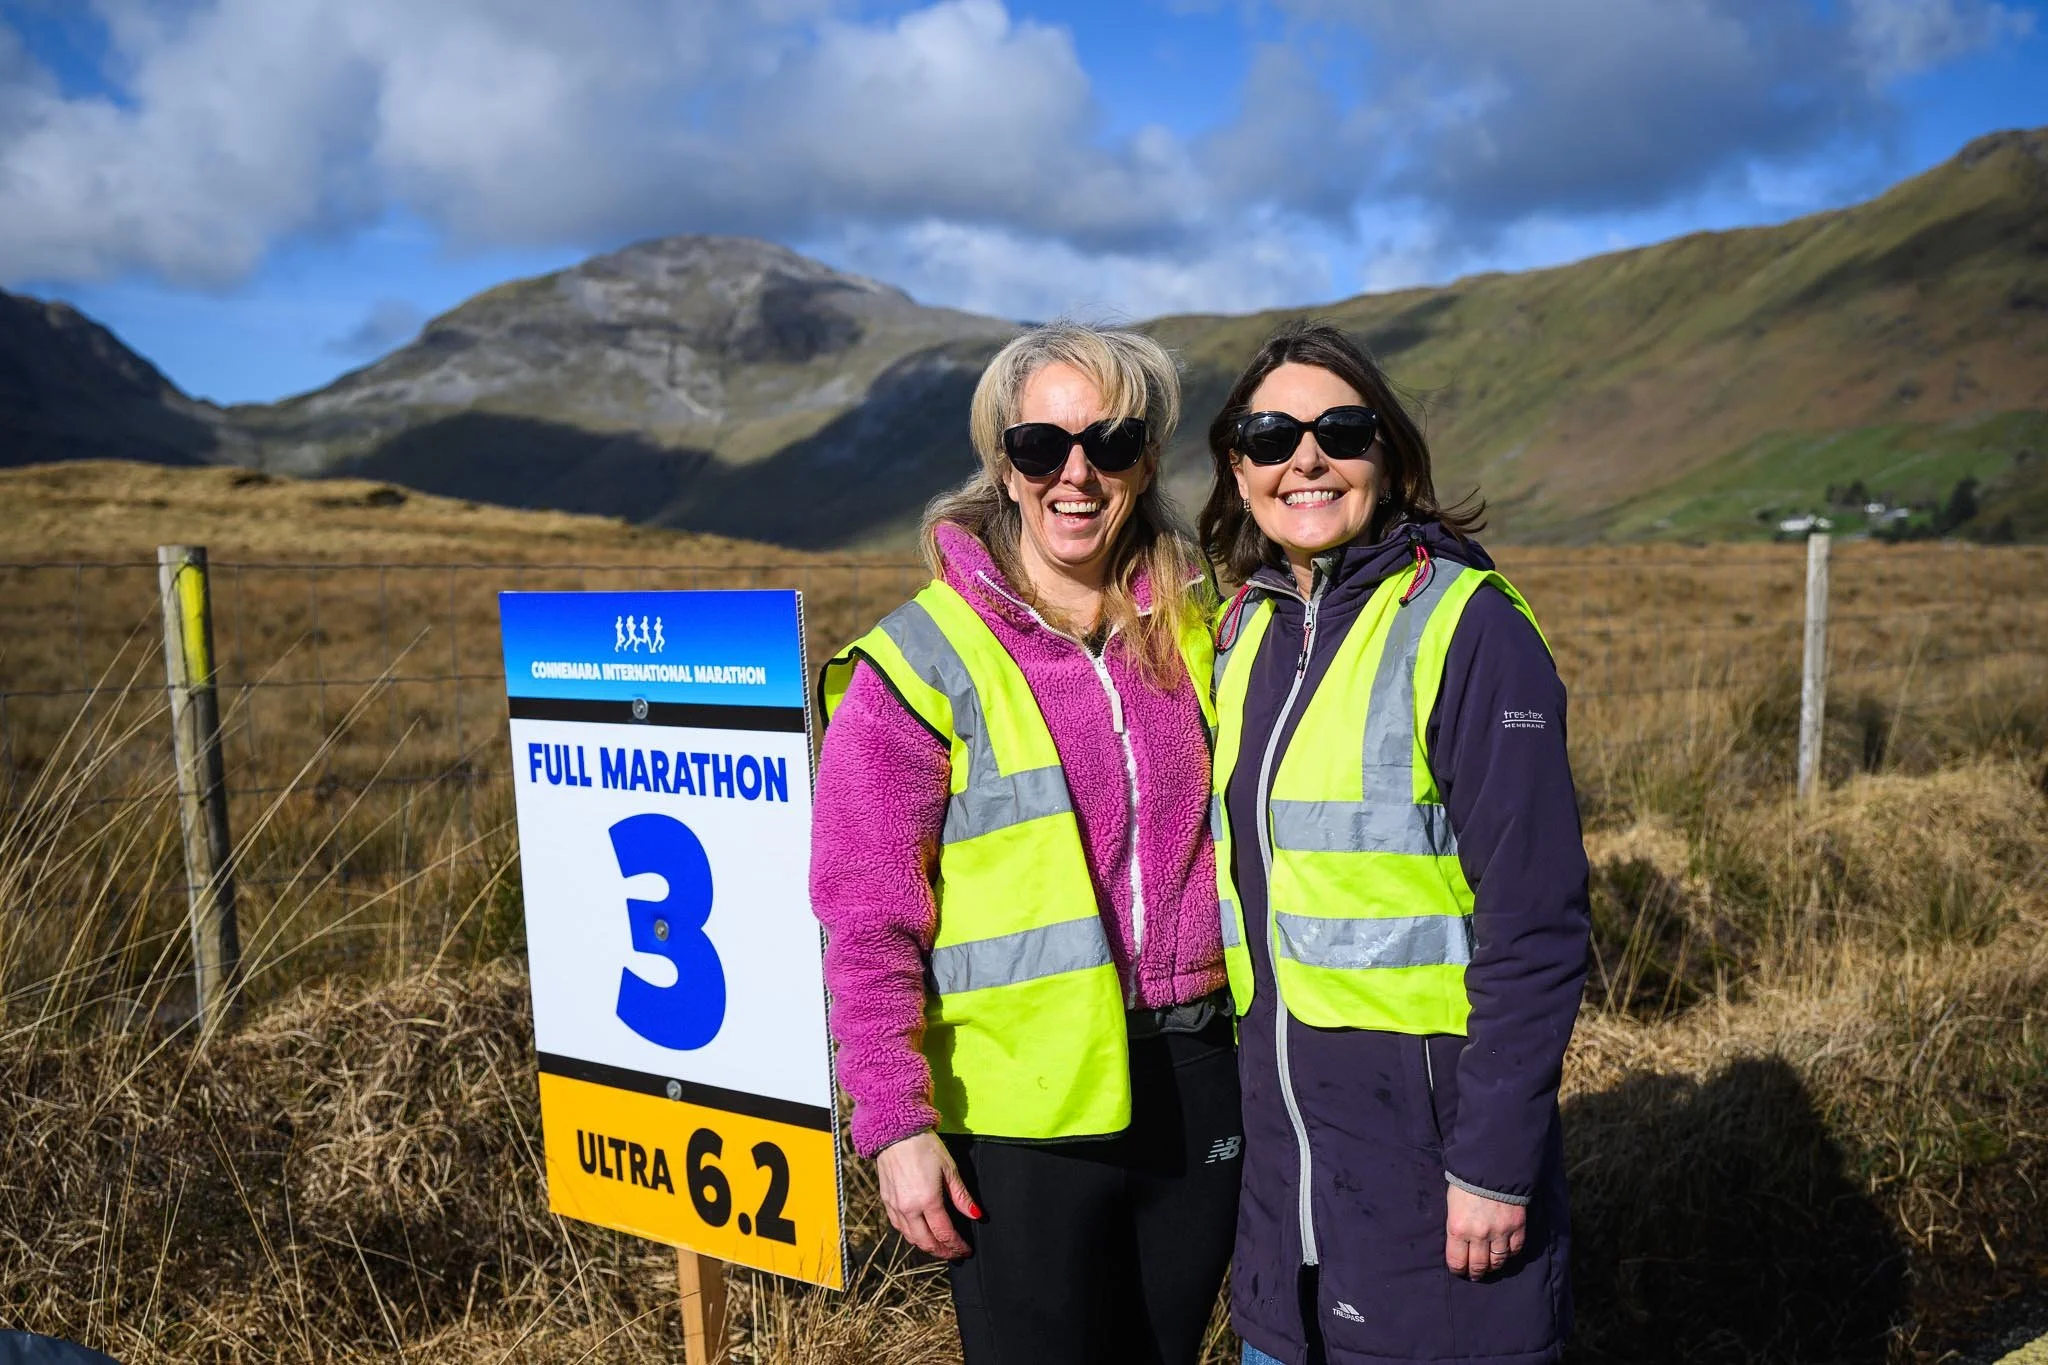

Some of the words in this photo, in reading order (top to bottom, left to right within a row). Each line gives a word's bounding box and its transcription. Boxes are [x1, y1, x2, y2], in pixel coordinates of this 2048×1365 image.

[531, 660, 601, 680] CONNEMARA
[602, 662, 693, 683] INTERNATIONAL
[694, 664, 767, 685] MARATHON
[1503, 709, 1544, 719] tres-tex
[528, 742, 592, 787] FULL
[600, 747, 789, 803] MARATHON
[608, 812, 727, 1051] 3
[577, 1129, 675, 1195] ULTRA
[686, 1127, 797, 1246] 6.2
[1332, 1307, 1365, 1323] TRESPASS
